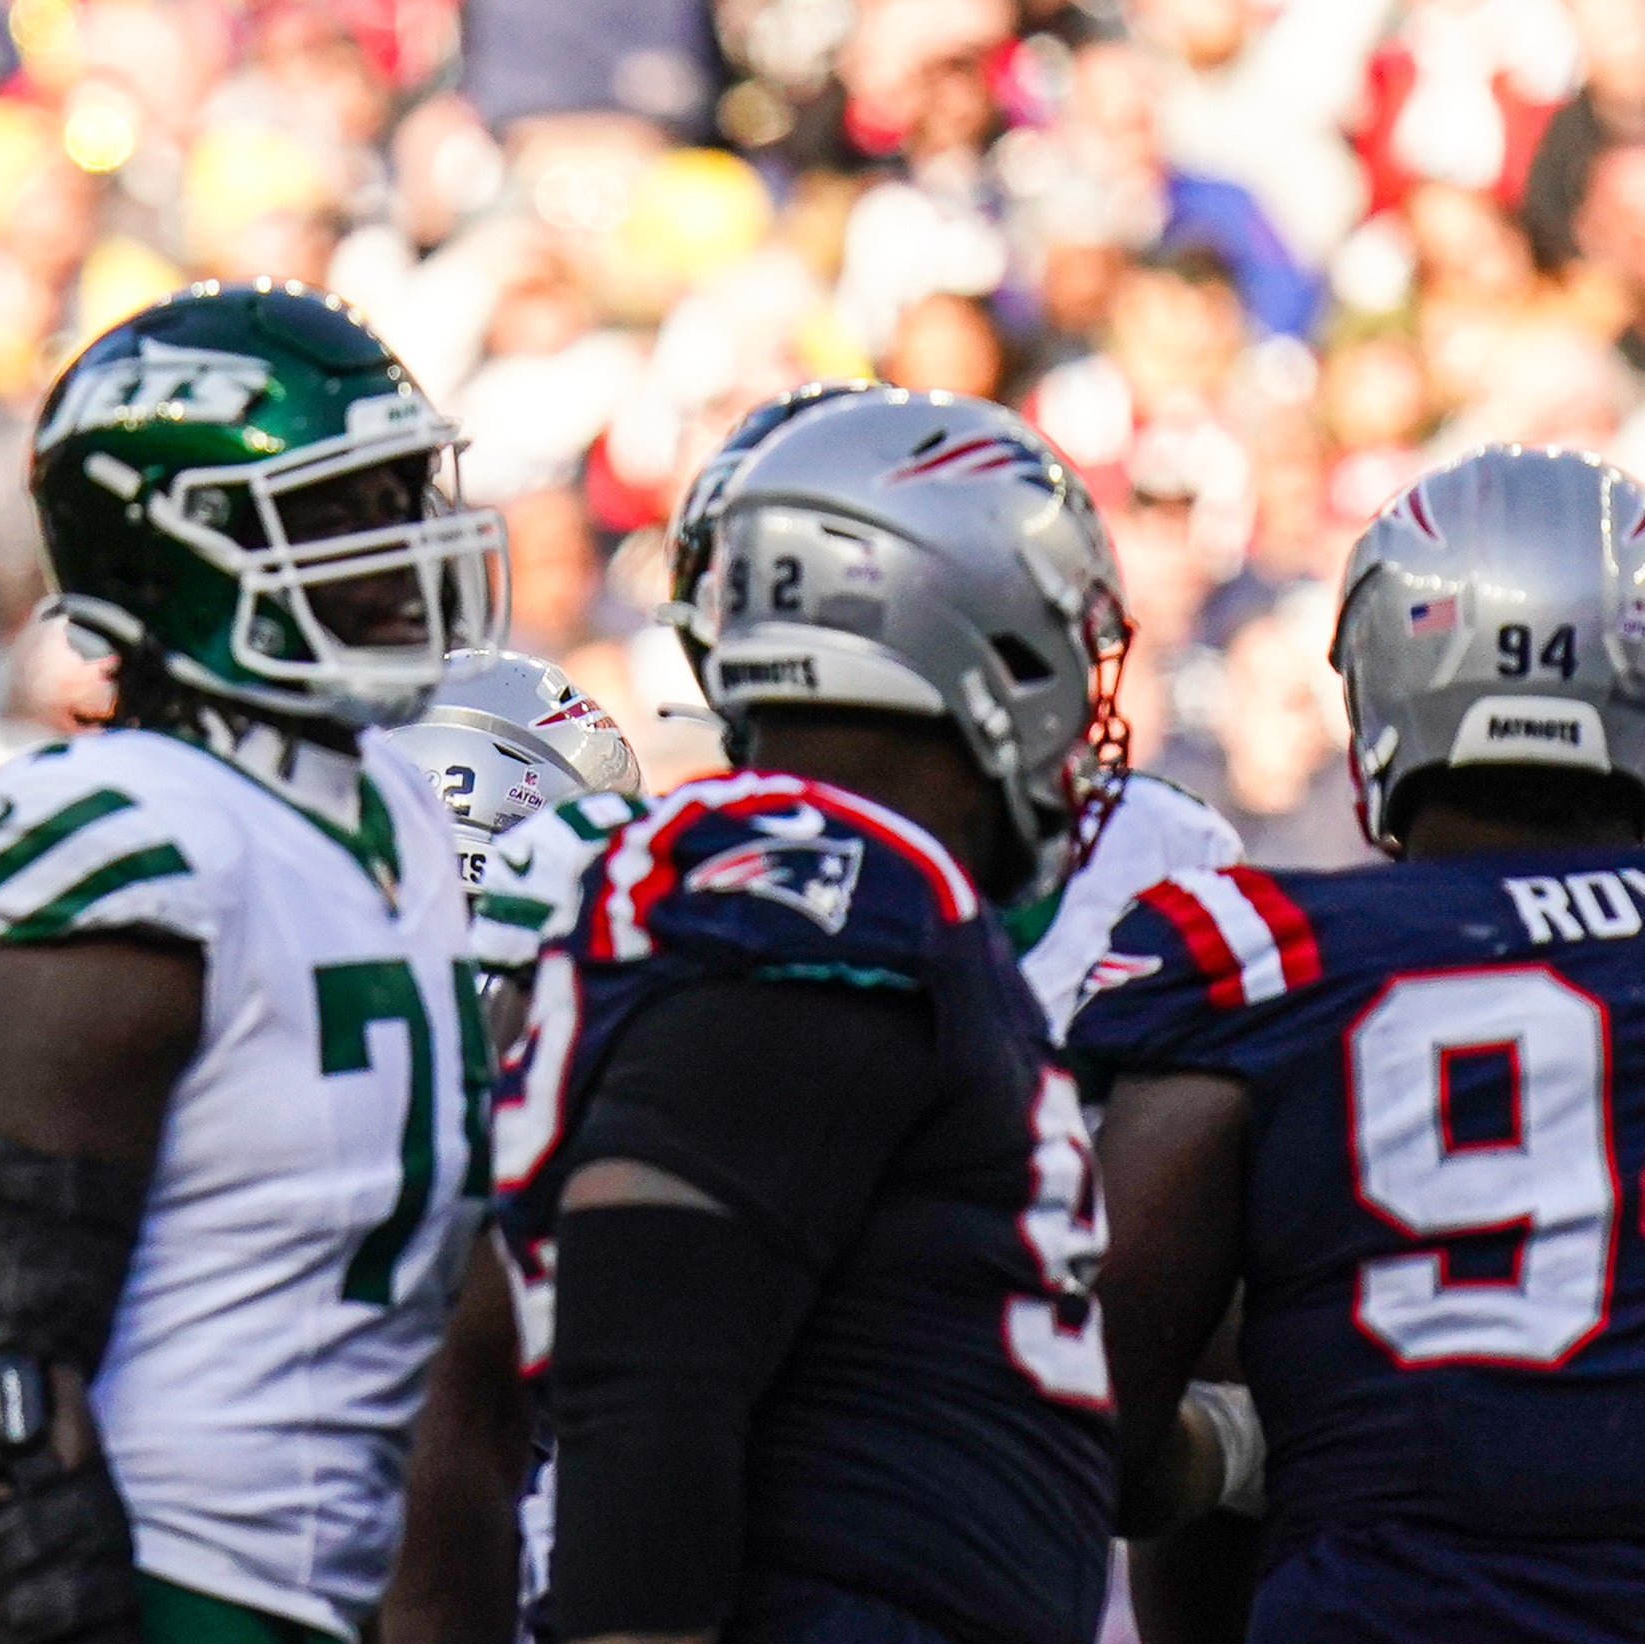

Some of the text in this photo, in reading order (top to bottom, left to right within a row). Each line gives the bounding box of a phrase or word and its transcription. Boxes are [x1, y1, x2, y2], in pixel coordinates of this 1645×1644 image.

[36, 338, 273, 454] JETS
[1497, 622, 1578, 681] 94
[508, 787, 543, 808] CATCH
[1504, 867, 1645, 944] RO
[315, 957, 498, 1306] 7
